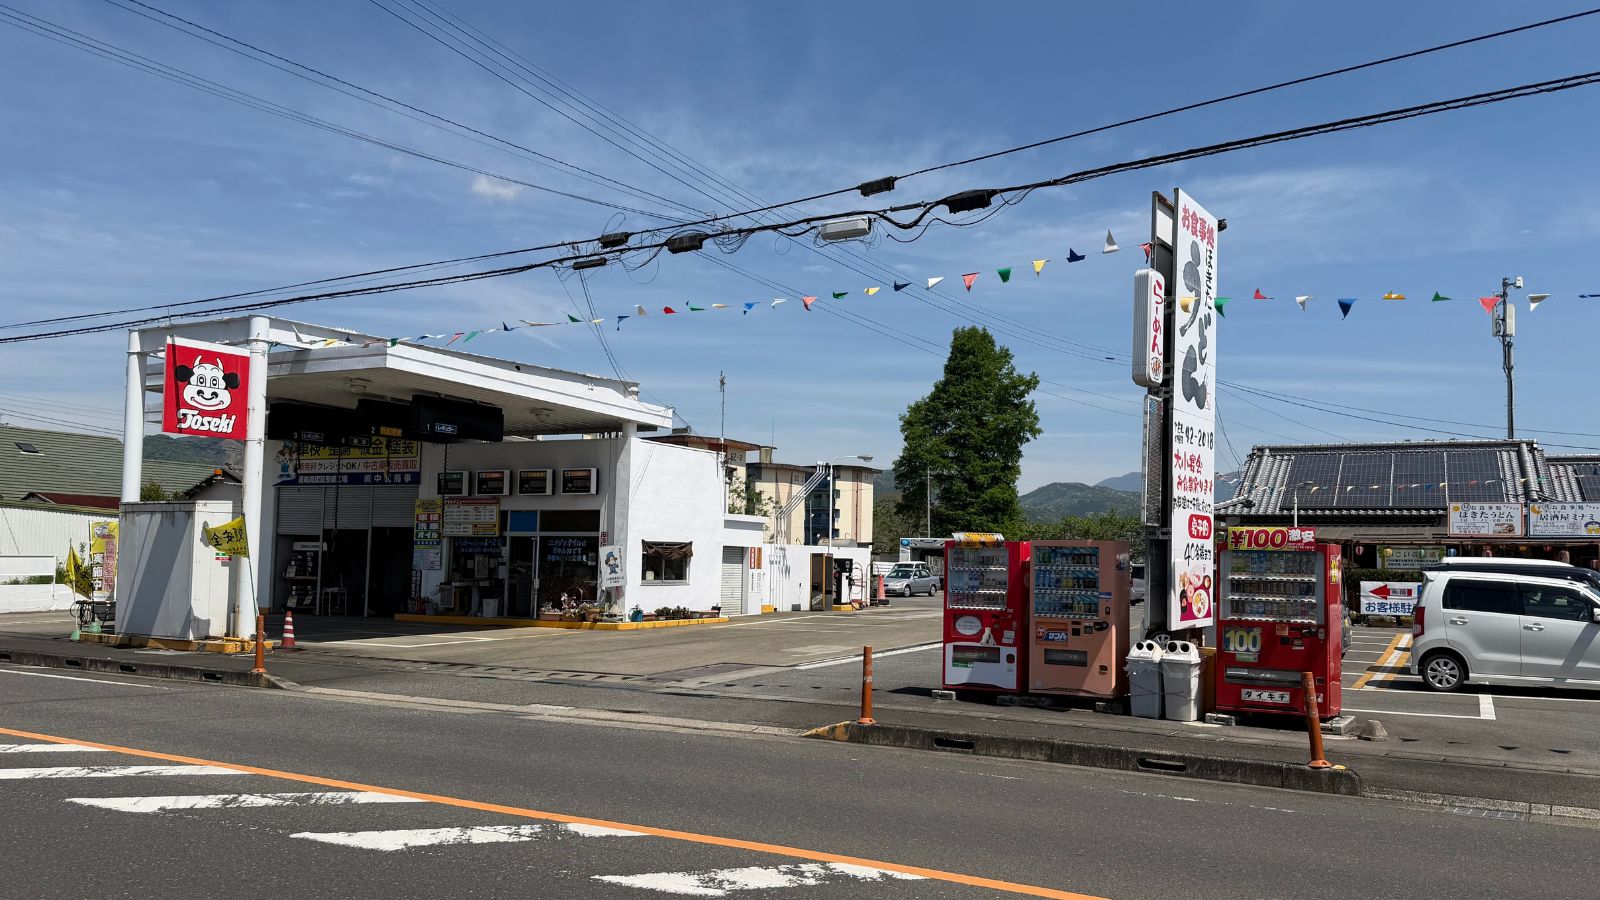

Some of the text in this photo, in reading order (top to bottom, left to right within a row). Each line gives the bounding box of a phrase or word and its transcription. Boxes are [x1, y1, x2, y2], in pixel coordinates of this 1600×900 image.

[1181, 204, 1214, 250] お食事処
[1152, 279, 1163, 356] らーめん
[1186, 426, 1213, 450] 42-2018
[1231, 529, 1288, 549] ¥100
[1365, 602, 1417, 614] お客様駐
[1245, 691, 1287, 701] タイキチ
